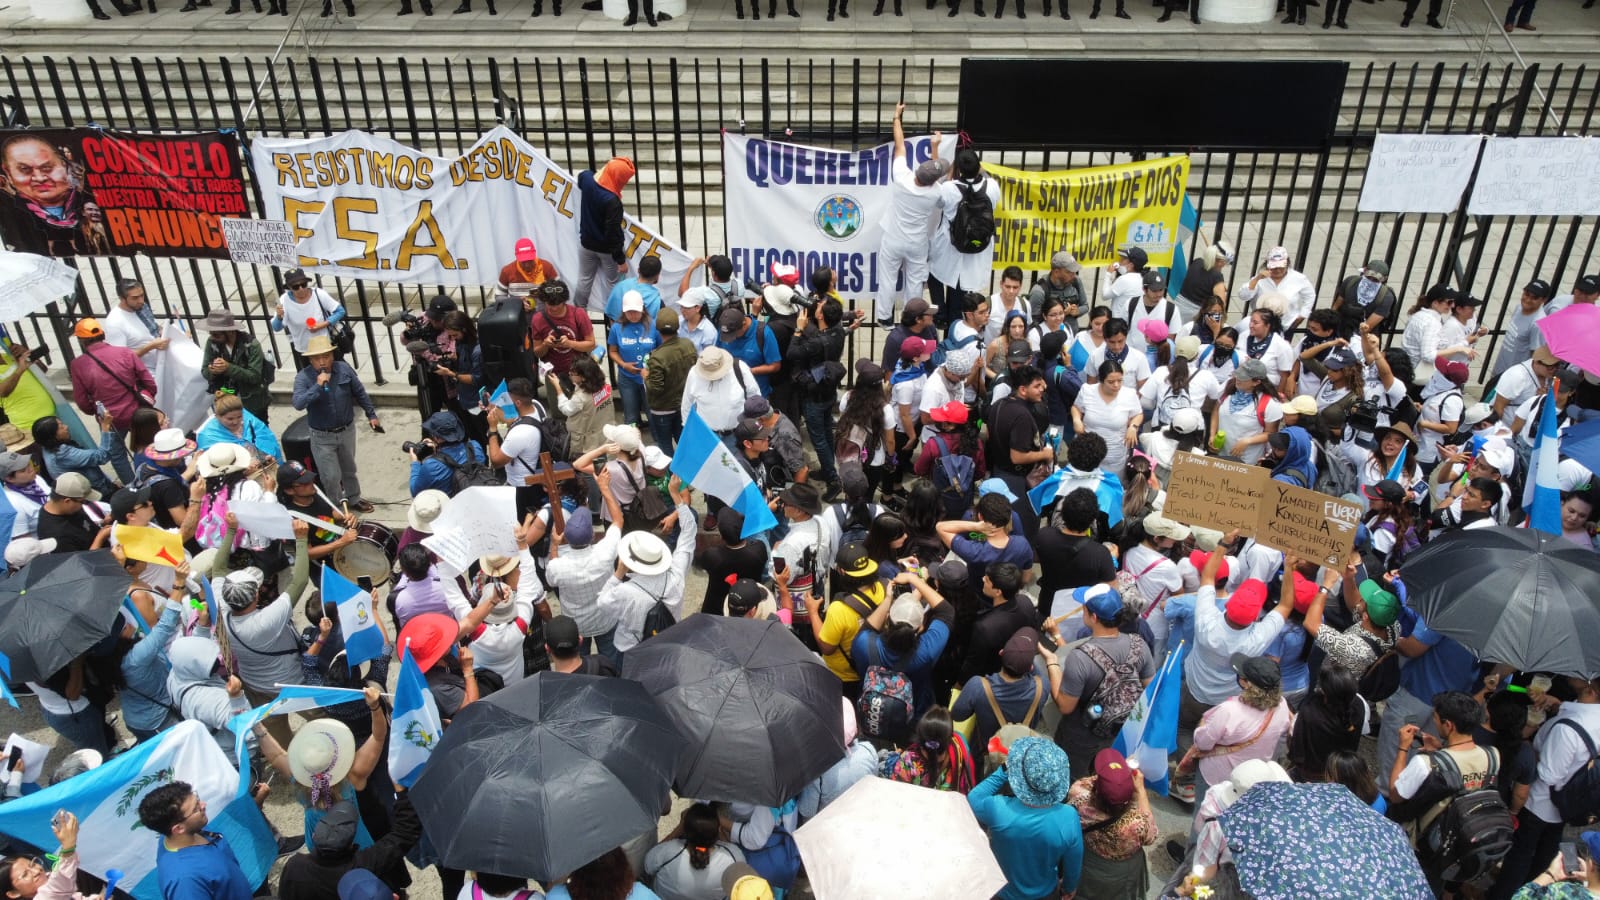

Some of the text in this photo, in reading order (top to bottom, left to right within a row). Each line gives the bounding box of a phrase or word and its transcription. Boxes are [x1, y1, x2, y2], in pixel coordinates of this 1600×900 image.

[82, 136, 231, 179] CONSUELO
[272, 147, 434, 190] RESISTIMOS
[449, 136, 533, 188] DESDE
[542, 169, 574, 219] EL
[93, 189, 246, 214] NUESTRA PRIMAVERA
[192, 179, 205, 193] TE
[207, 179, 242, 193] ROBES
[1039, 179, 1071, 212] SAN
[1073, 172, 1118, 212] JUAN
[1119, 170, 1143, 209] DE
[1144, 163, 1183, 207] DIOS
[1030, 218, 1049, 262] EN
[1050, 218, 1069, 256] LA
[1073, 216, 1117, 262] LUCHA
